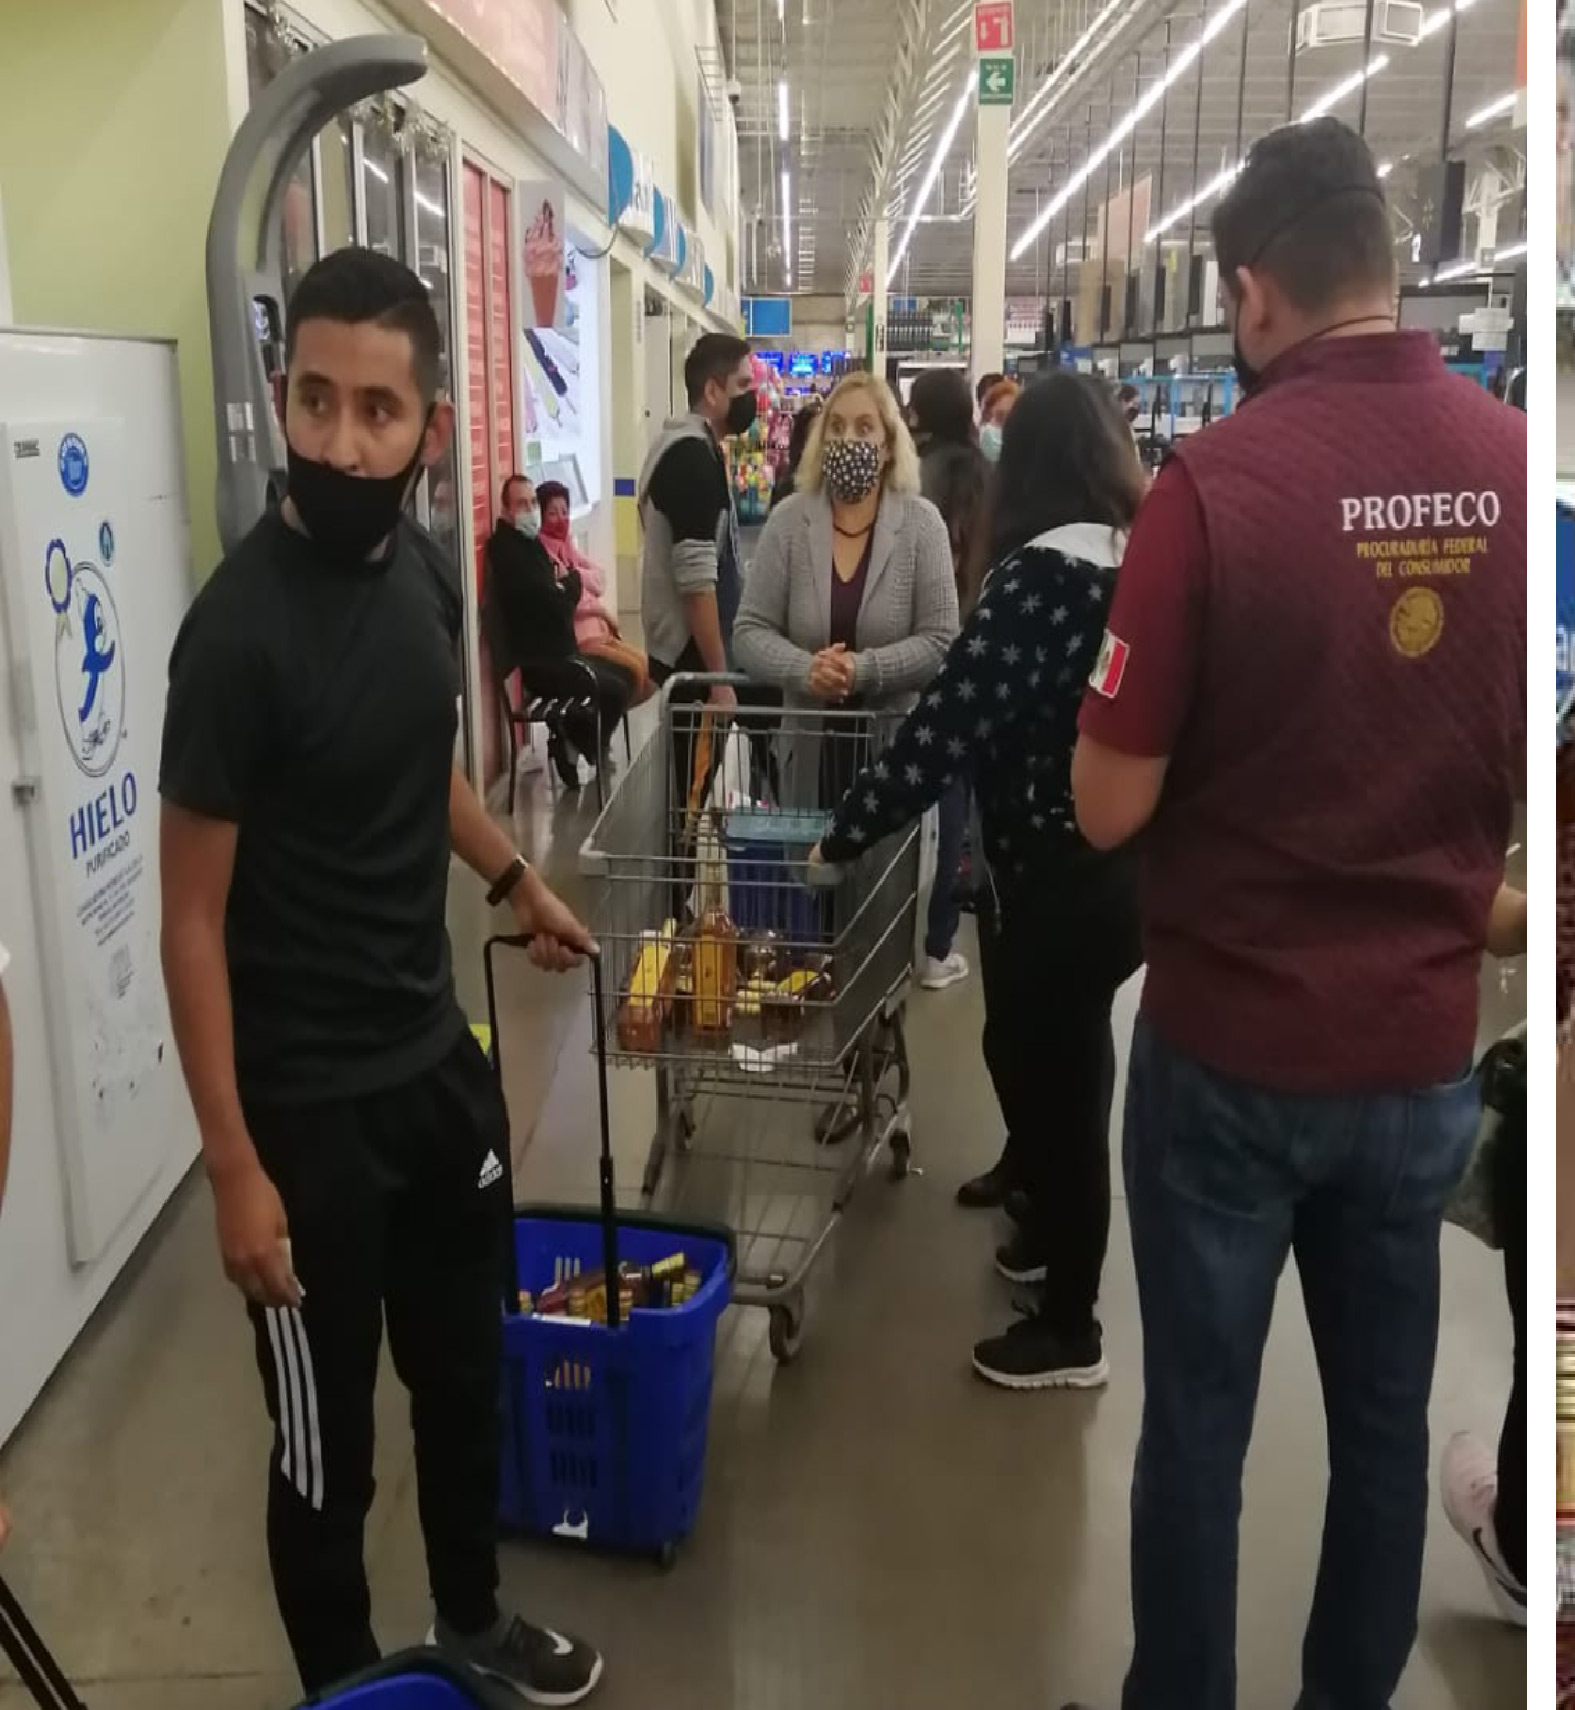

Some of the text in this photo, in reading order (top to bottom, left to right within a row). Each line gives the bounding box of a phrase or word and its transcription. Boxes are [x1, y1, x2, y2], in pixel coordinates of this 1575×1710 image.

[1340, 490, 1501, 532] PROFECO
[1443, 536, 1488, 555] FEDERAL
[1376, 561, 1393, 578] DEL
[68, 770, 138, 860] HIELO
[85, 829, 131, 878] PURIFICADO
